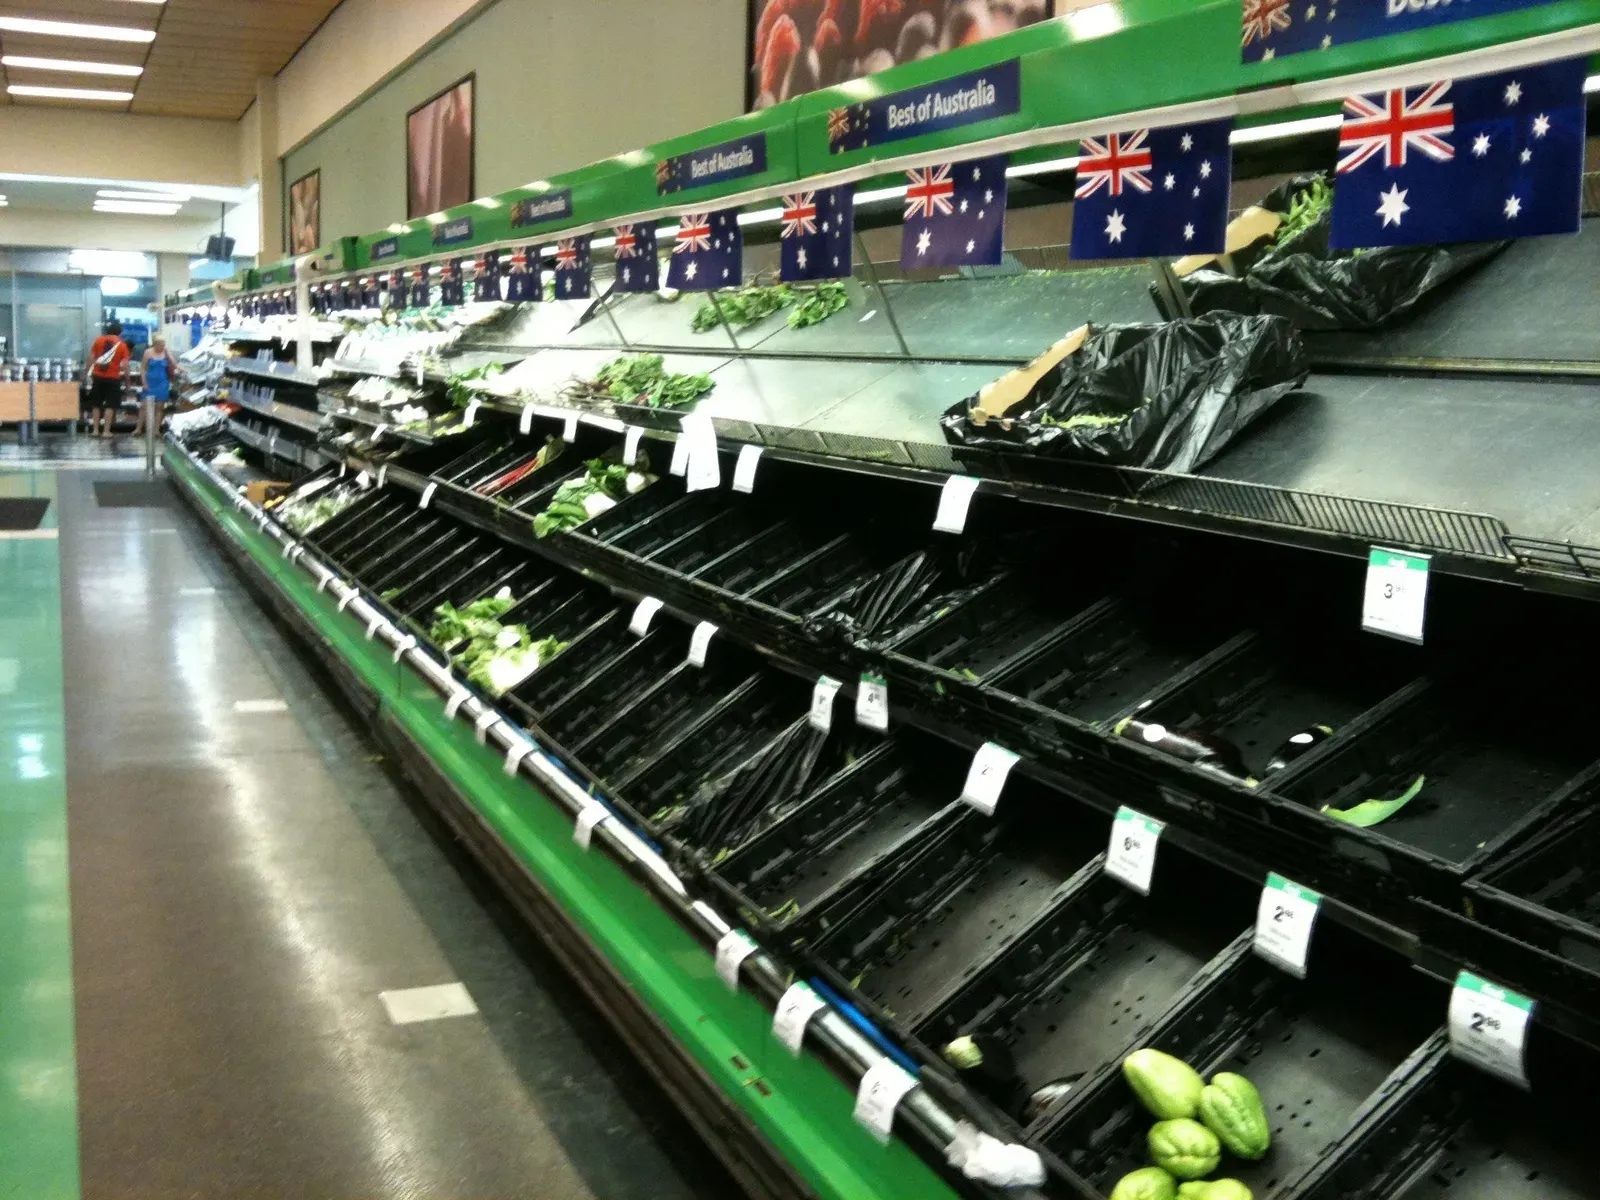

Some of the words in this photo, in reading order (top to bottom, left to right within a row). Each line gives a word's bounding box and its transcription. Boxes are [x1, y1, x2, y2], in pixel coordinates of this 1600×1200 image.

[887, 102, 916, 131] Best
[917, 93, 932, 123] of
[933, 78, 996, 119] Australia
[691, 158, 709, 179] Best
[718, 145, 754, 171] Australia
